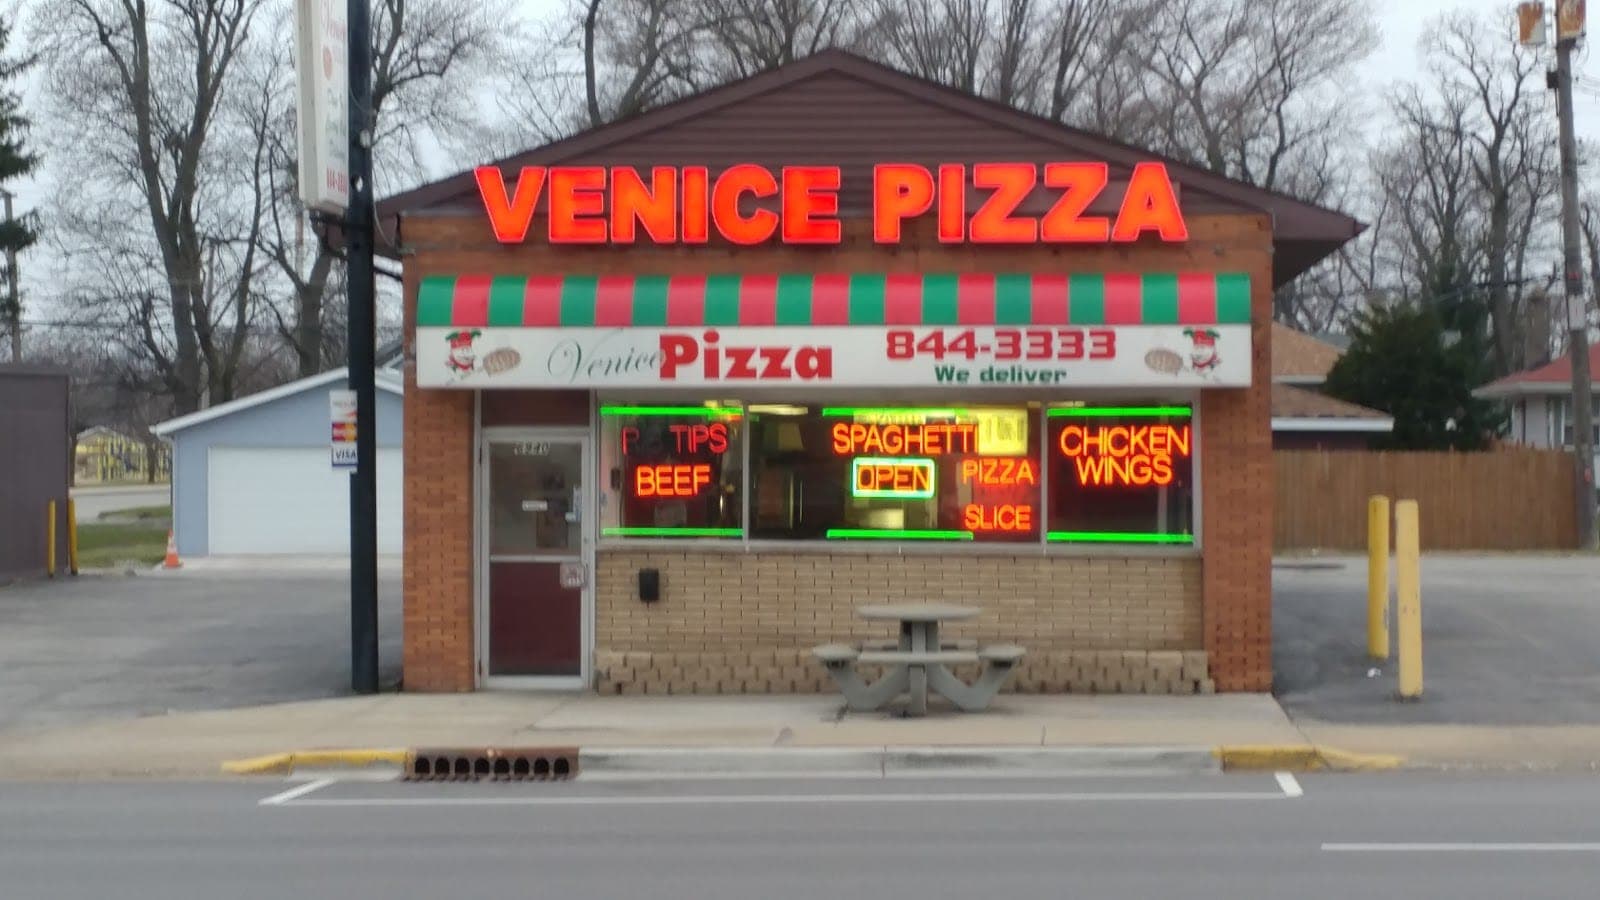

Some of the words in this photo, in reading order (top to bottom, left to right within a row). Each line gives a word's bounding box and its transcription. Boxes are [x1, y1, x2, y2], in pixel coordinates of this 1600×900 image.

[474, 164, 841, 244] VENICE
[874, 162, 1189, 243] PIZZA
[548, 328, 664, 381] Venice
[659, 329, 833, 380] Pizza
[886, 329, 1117, 361] 844-3333
[935, 365, 970, 384] We
[979, 365, 1067, 384] deliver
[336, 449, 357, 459] VISA
[669, 423, 728, 454] TIPS
[832, 423, 979, 455] SPAGHETTI
[1060, 426, 1190, 457] CHICKEN
[636, 465, 711, 497] BEEF
[857, 466, 930, 492] OPEN
[962, 459, 1035, 485] PIZZA
[1076, 455, 1173, 485] WINGS
[964, 505, 1031, 531] SLICE
